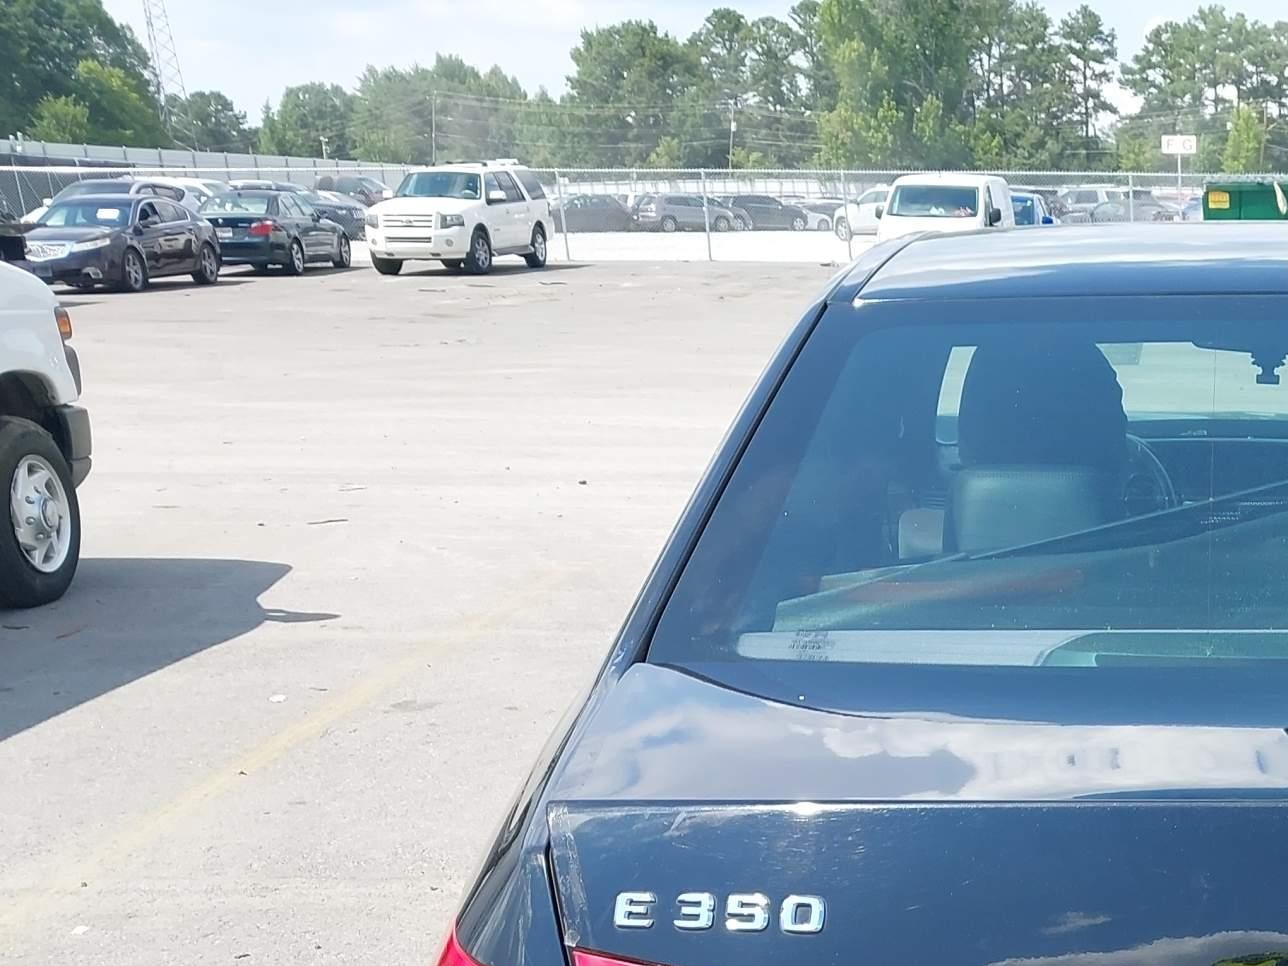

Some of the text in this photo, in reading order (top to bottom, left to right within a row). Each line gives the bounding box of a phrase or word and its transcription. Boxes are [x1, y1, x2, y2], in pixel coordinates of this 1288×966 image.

[1183, 139, 1193, 151] G
[613, 891, 827, 934] E 350
